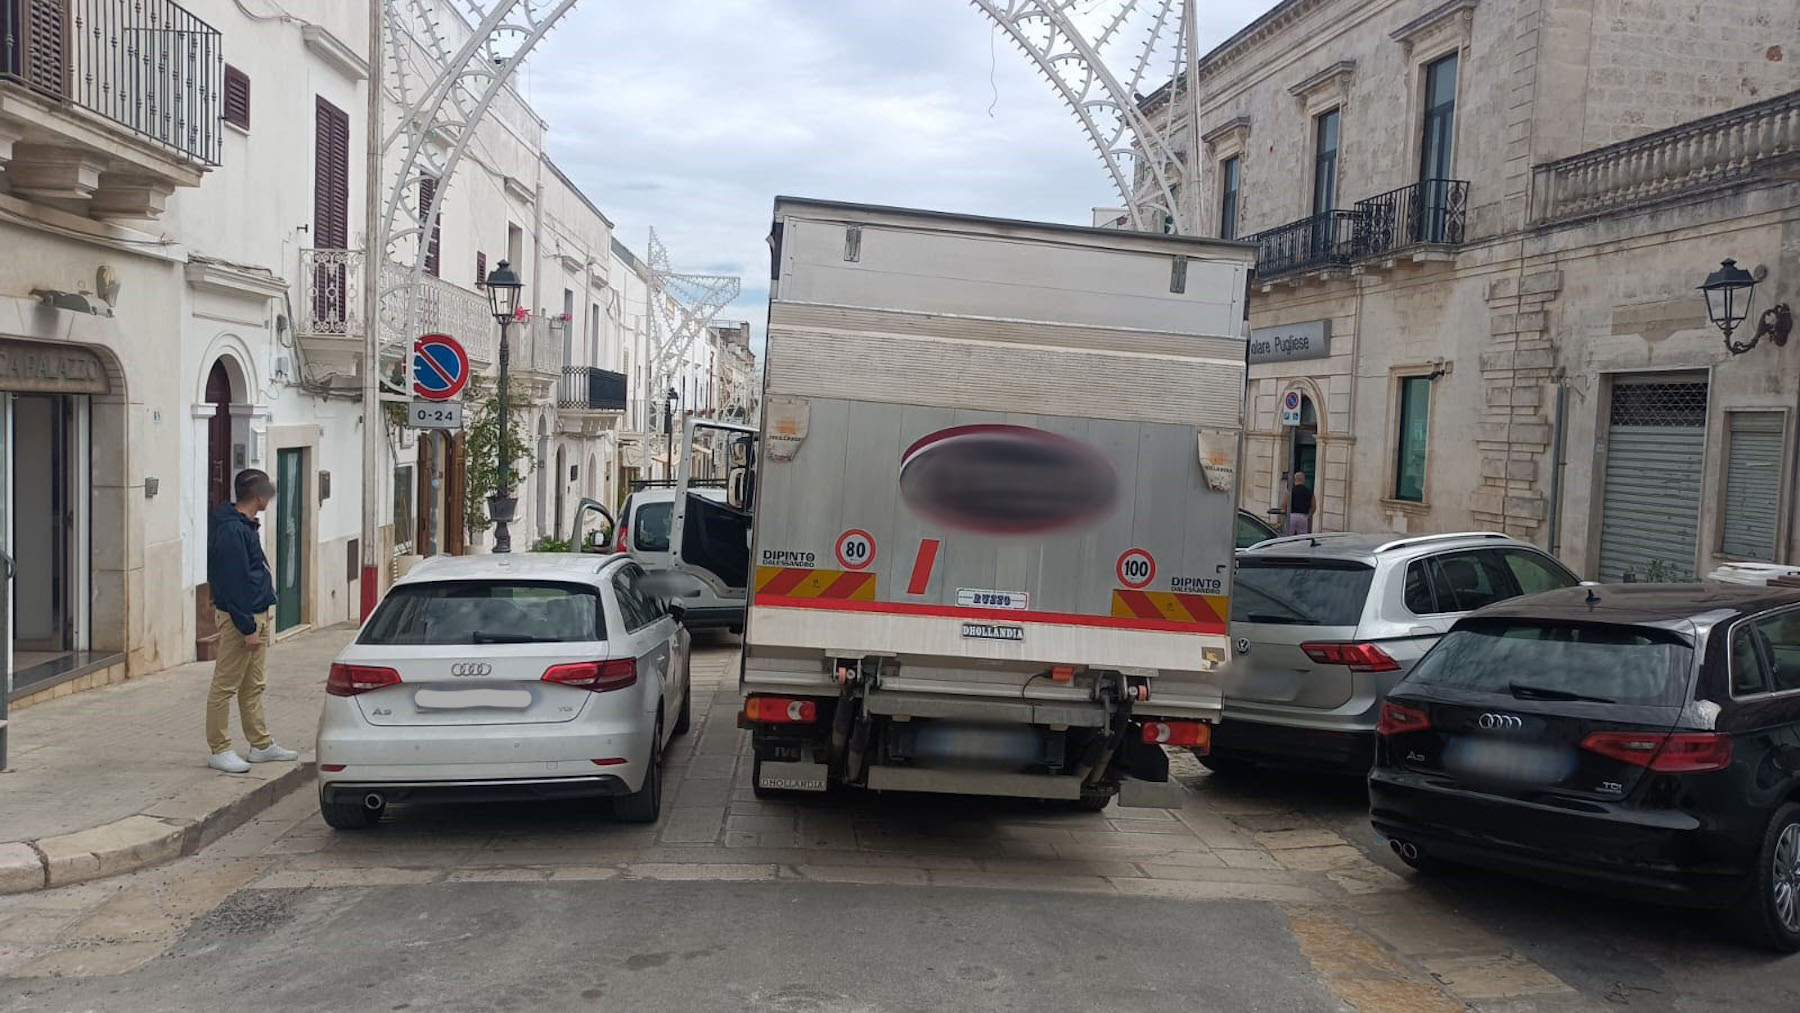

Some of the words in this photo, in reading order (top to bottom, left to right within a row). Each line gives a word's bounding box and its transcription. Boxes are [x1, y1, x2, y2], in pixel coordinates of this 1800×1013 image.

[1274, 335, 1310, 355] Pugliese
[417, 409, 453, 421] 0-24
[763, 550, 815, 562] DIPINTO
[846, 541, 866, 558] 80
[1124, 560, 1149, 577] 100
[1171, 577, 1221, 588] DIPINTO
[963, 625, 1023, 639] DHOLLANDIA
